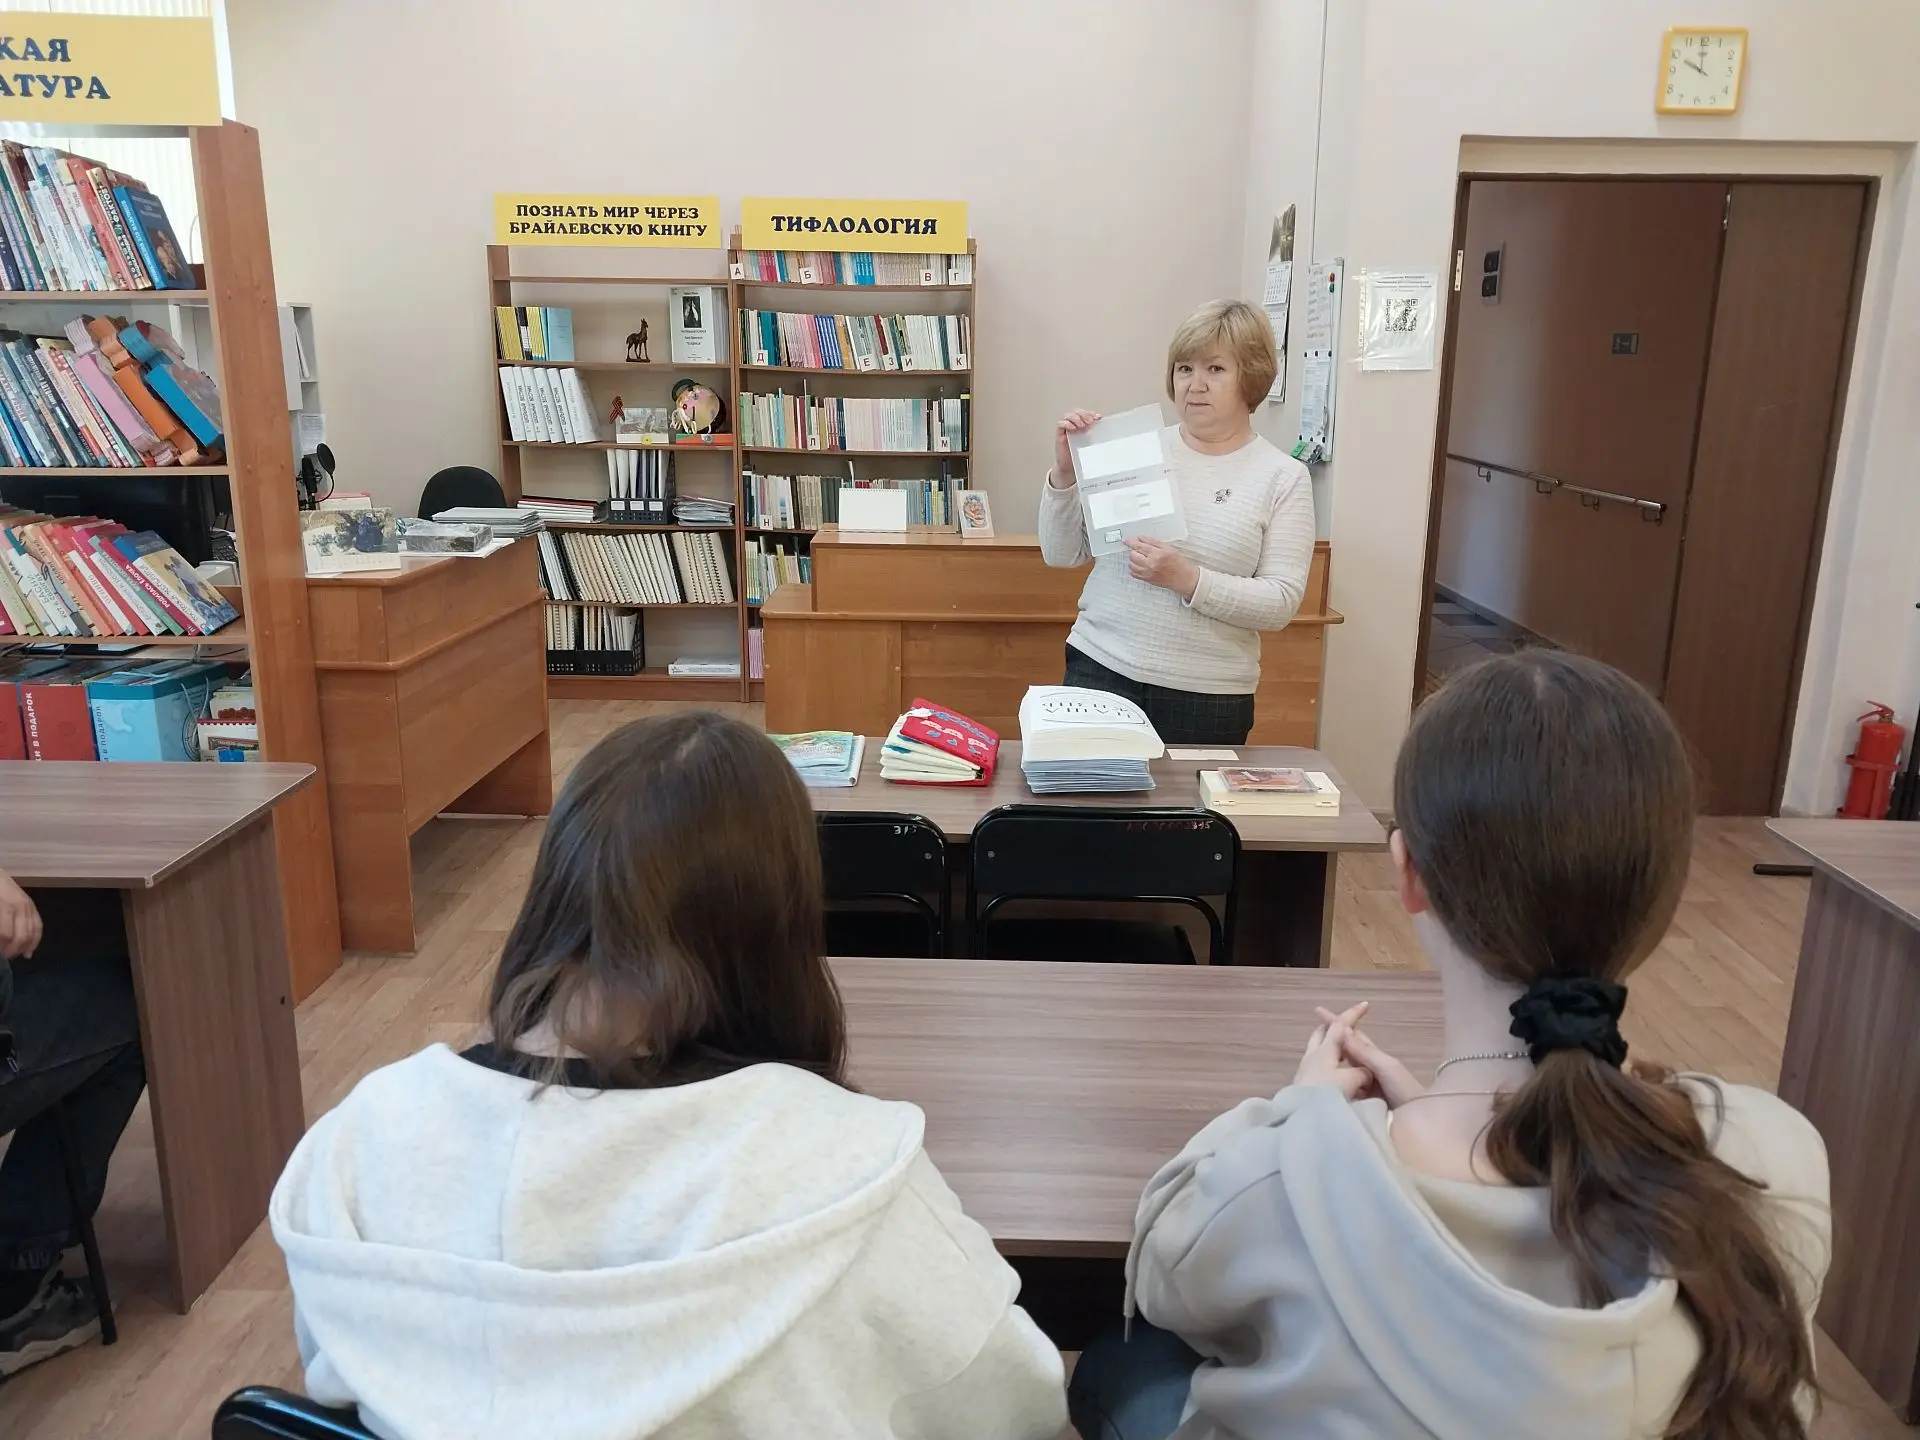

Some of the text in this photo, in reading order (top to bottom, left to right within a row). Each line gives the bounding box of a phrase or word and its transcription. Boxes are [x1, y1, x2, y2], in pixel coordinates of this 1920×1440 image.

[0, 36, 71, 62] КАЯ
[101, 187, 119, 222] ФАКТОВ
[516, 204, 699, 219] ПОЗНАТЬ МИР ЧЕРЕЗ
[509, 219, 707, 237] БРАЙЛЕВСКУЮ КНИГУ
[770, 215, 938, 235] ТИФЛОЛОГИЯ
[734, 267, 742, 276] А
[804, 270, 812, 279] Б
[924, 272, 932, 281] В
[954, 272, 959, 281] Г
[757, 353, 764, 363] Д
[863, 358, 871, 367] Е
[905, 358, 912, 367] И
[956, 357, 963, 366] К
[810, 437, 816, 446] Л
[763, 518, 770, 526] Н
[143, 581, 170, 608] РОДИЛАСЬ
[25, 692, 38, 737] ПОДАРОК
